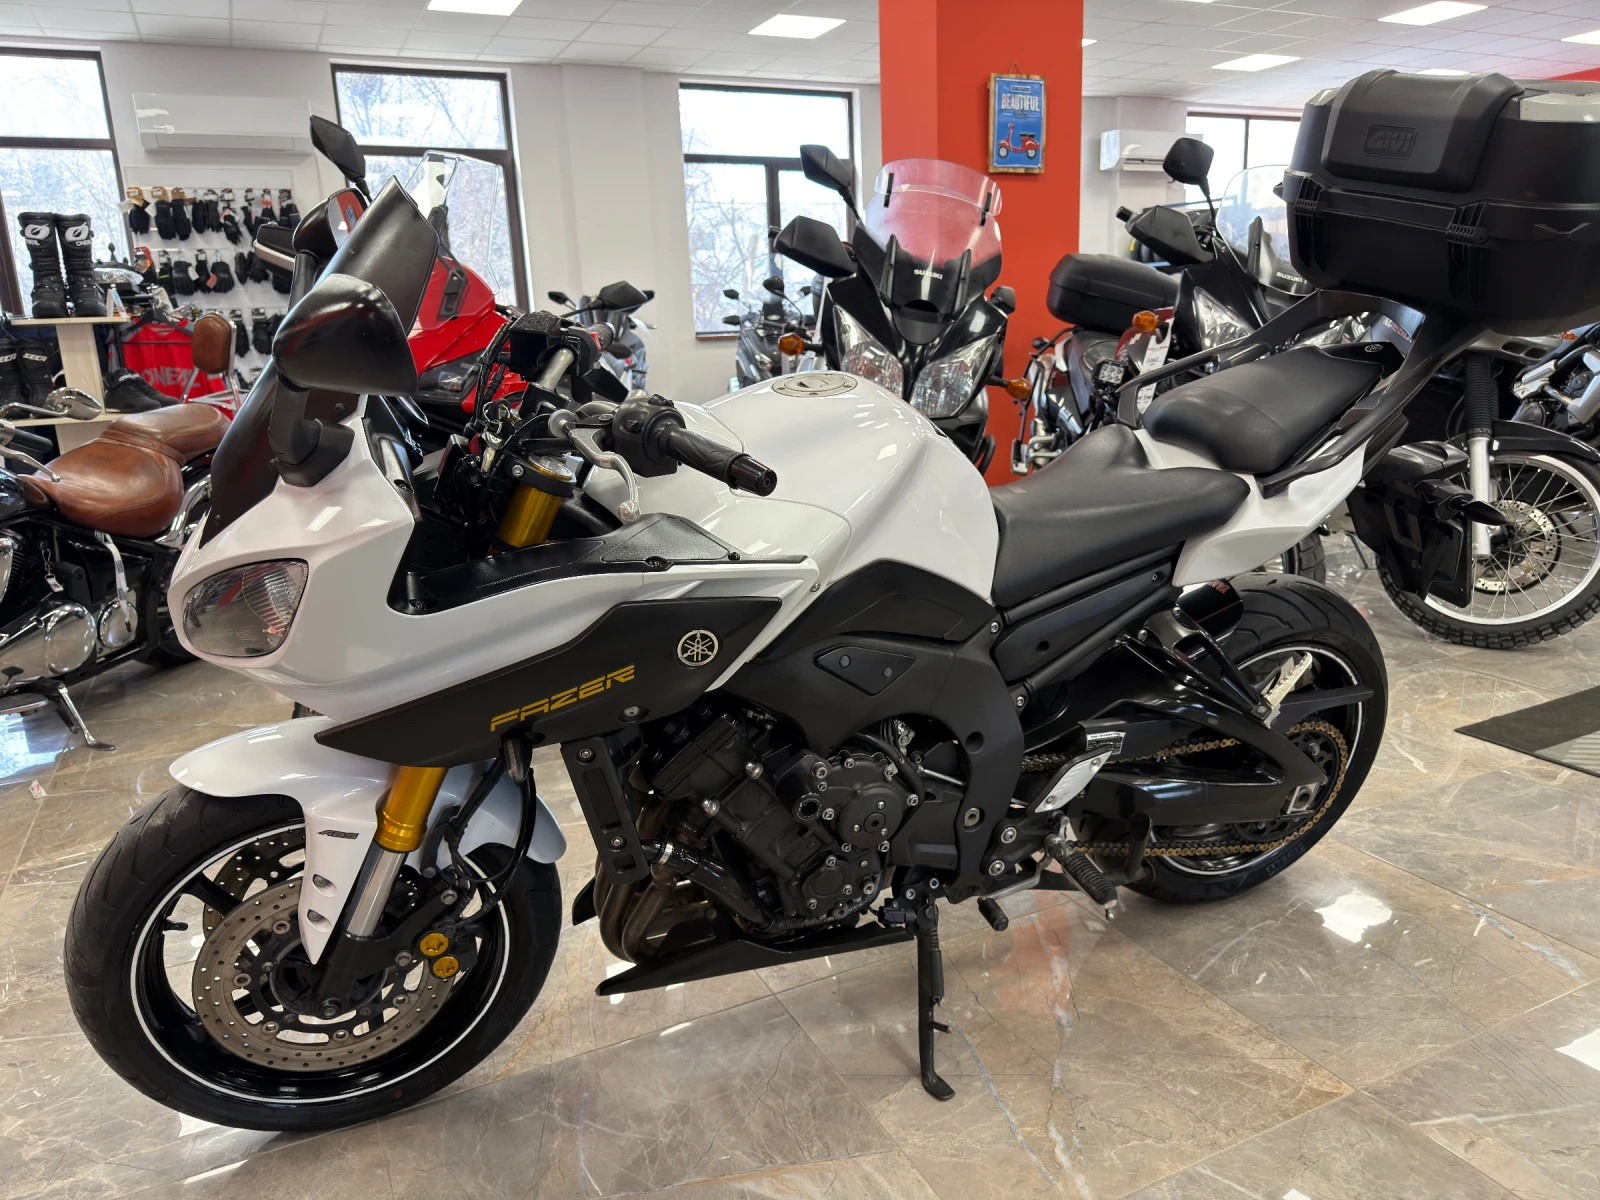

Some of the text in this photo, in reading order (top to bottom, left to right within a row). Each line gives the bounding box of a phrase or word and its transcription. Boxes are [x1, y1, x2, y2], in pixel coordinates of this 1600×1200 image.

[1001, 93, 1040, 111] BEAUTIFUL
[1367, 130, 1414, 153] GIVI
[913, 269, 944, 280] SUZUKI
[1276, 271, 1303, 282] SUZUKI
[23, 352, 48, 362] SECA
[490, 663, 635, 732] FAZER
[317, 829, 360, 840] ABS
